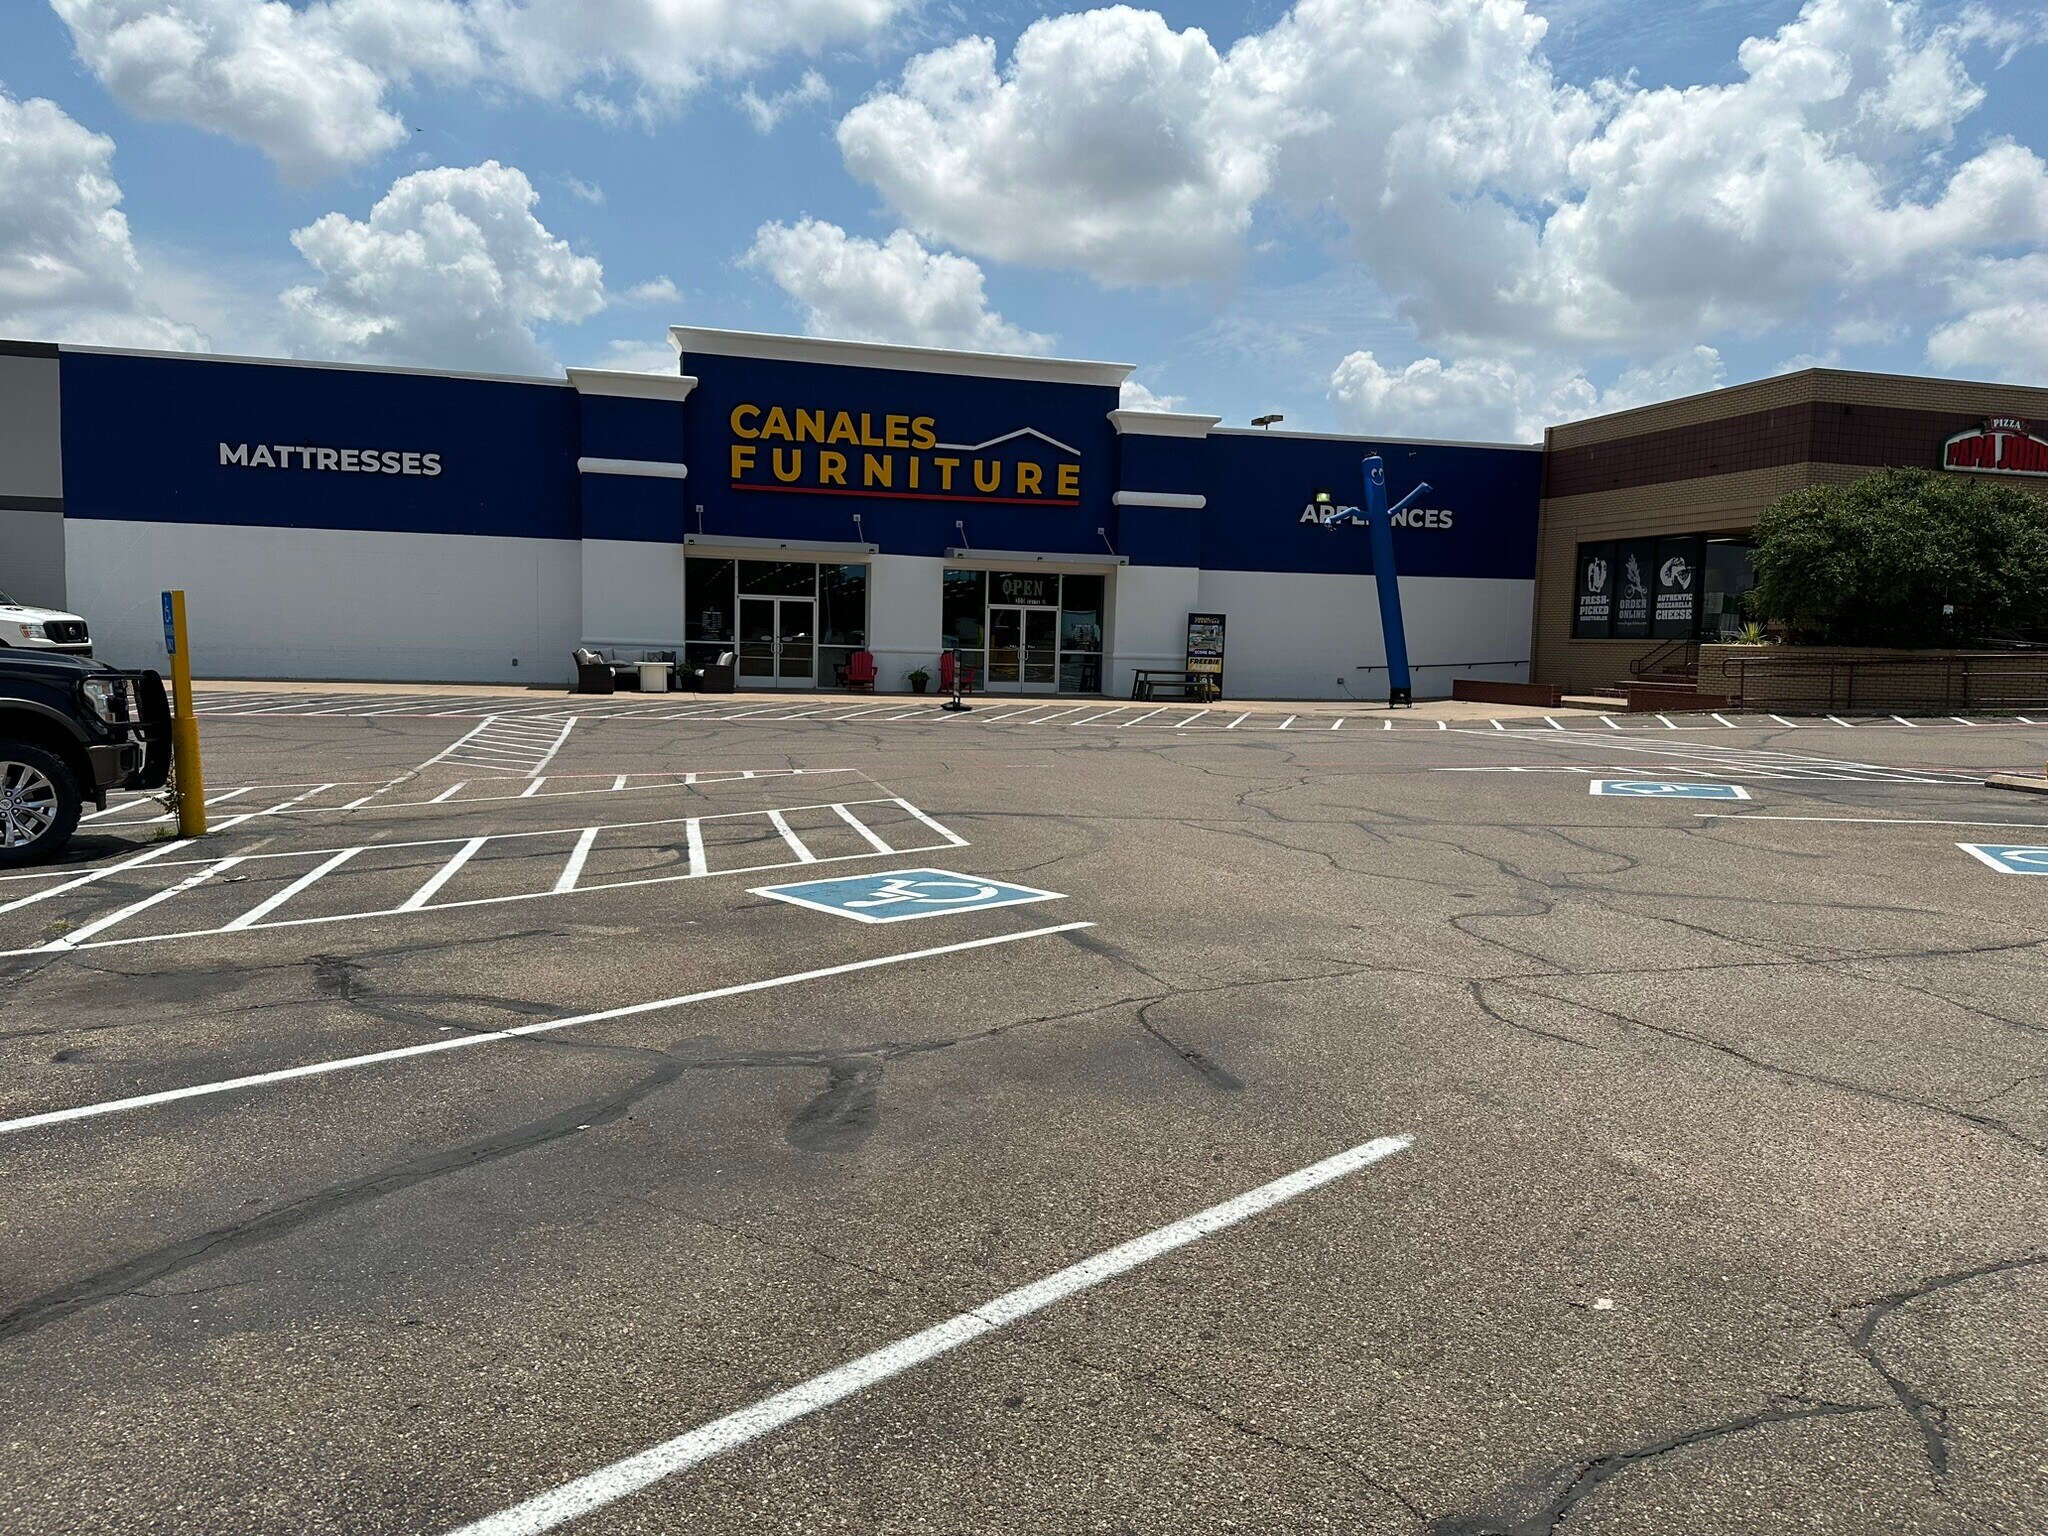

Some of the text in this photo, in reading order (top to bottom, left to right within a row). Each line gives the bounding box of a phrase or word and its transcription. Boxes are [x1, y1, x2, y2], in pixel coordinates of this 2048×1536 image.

[730, 404, 936, 450] CANALES
[1993, 418, 2022, 432] PIZZA
[1947, 433, 1996, 469] PAPA
[219, 442, 442, 477] MATTRESSES
[731, 445, 1081, 497] FURNITURE
[1002, 579, 1044, 597] OPEN
[1580, 595, 1610, 605] FRESH-
[1656, 593, 1693, 602] AUTHENTIC
[1619, 598, 1647, 609] ORDER
[1656, 601, 1693, 609] MOZZARELLA
[1579, 605, 1610, 615] PICKED
[1618, 609, 1647, 619] ONLINE
[1655, 609, 1693, 620] CHEESE
